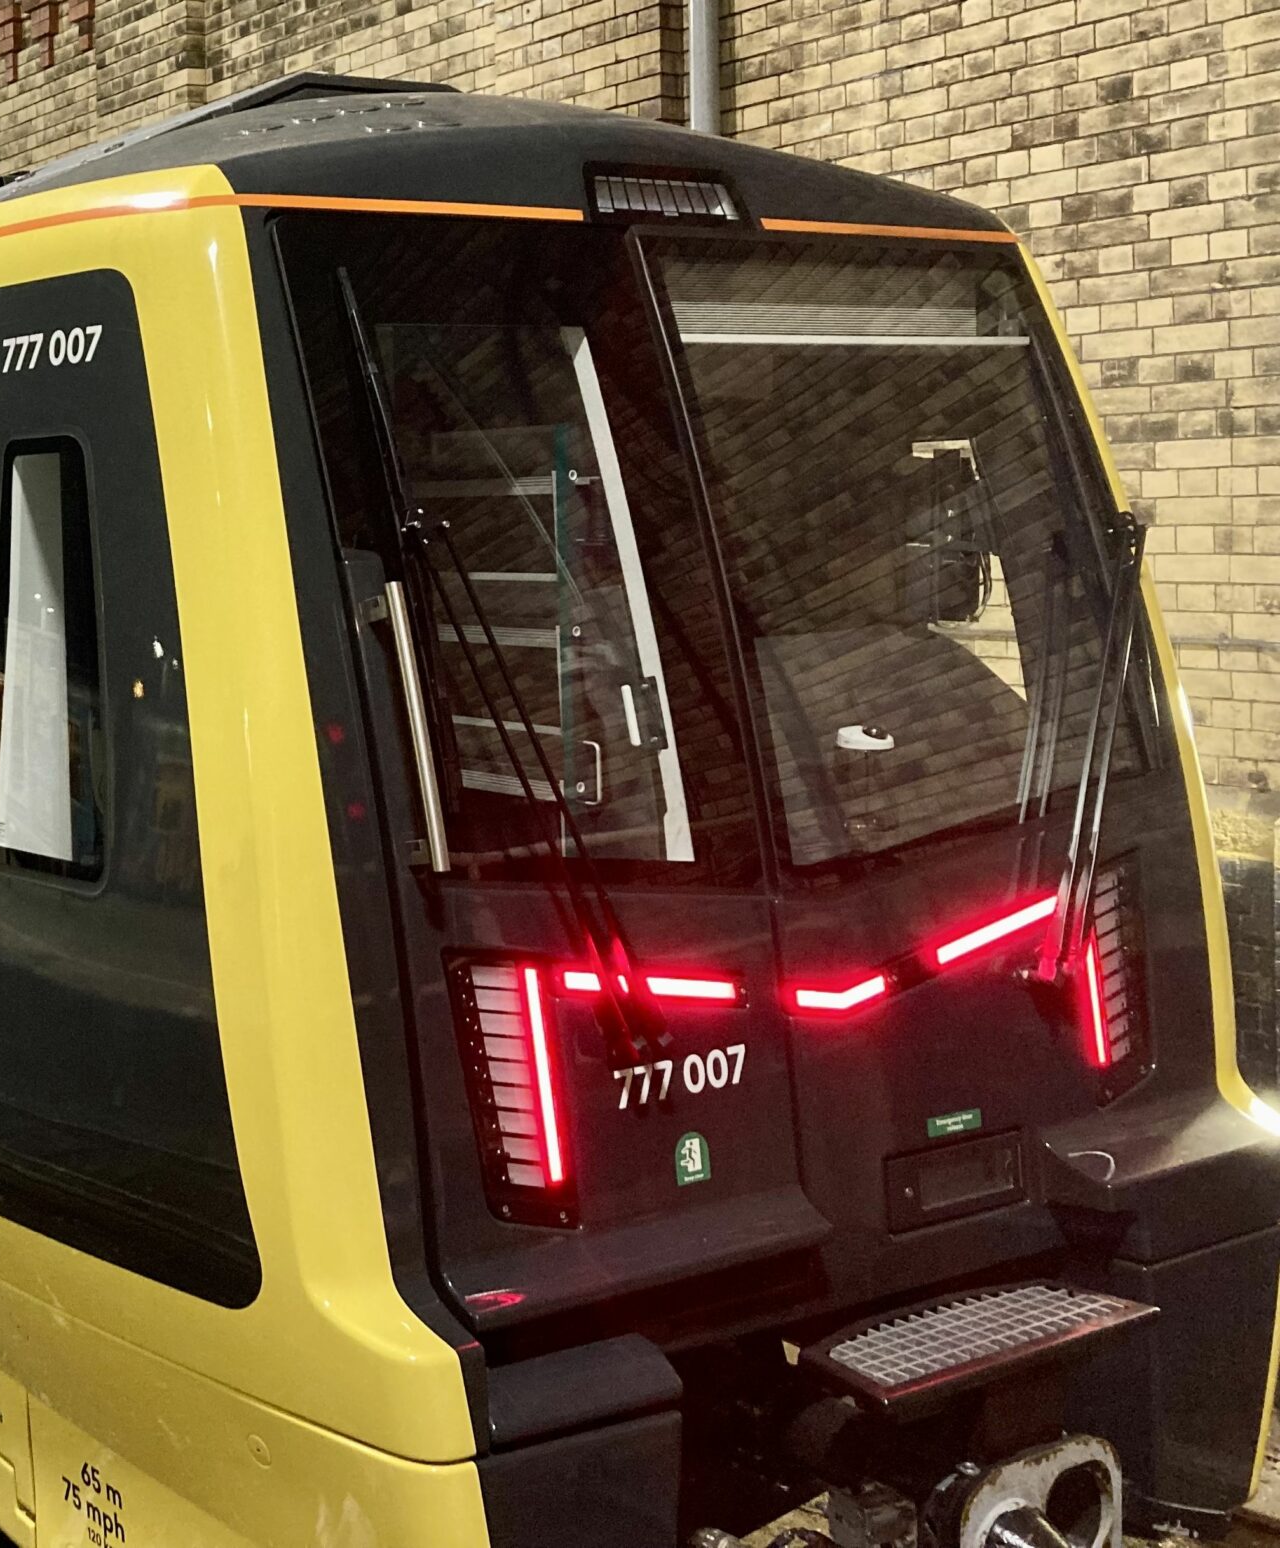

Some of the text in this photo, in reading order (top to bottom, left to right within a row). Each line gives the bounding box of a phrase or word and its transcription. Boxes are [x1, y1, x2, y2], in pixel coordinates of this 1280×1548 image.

[2, 325, 103, 374] 777 007
[613, 1044, 746, 1110] 777 007
[62, 1476, 126, 1543] 75 mph
[81, 1462, 123, 1510] 65 m
[87, 1527, 102, 1547] 120
